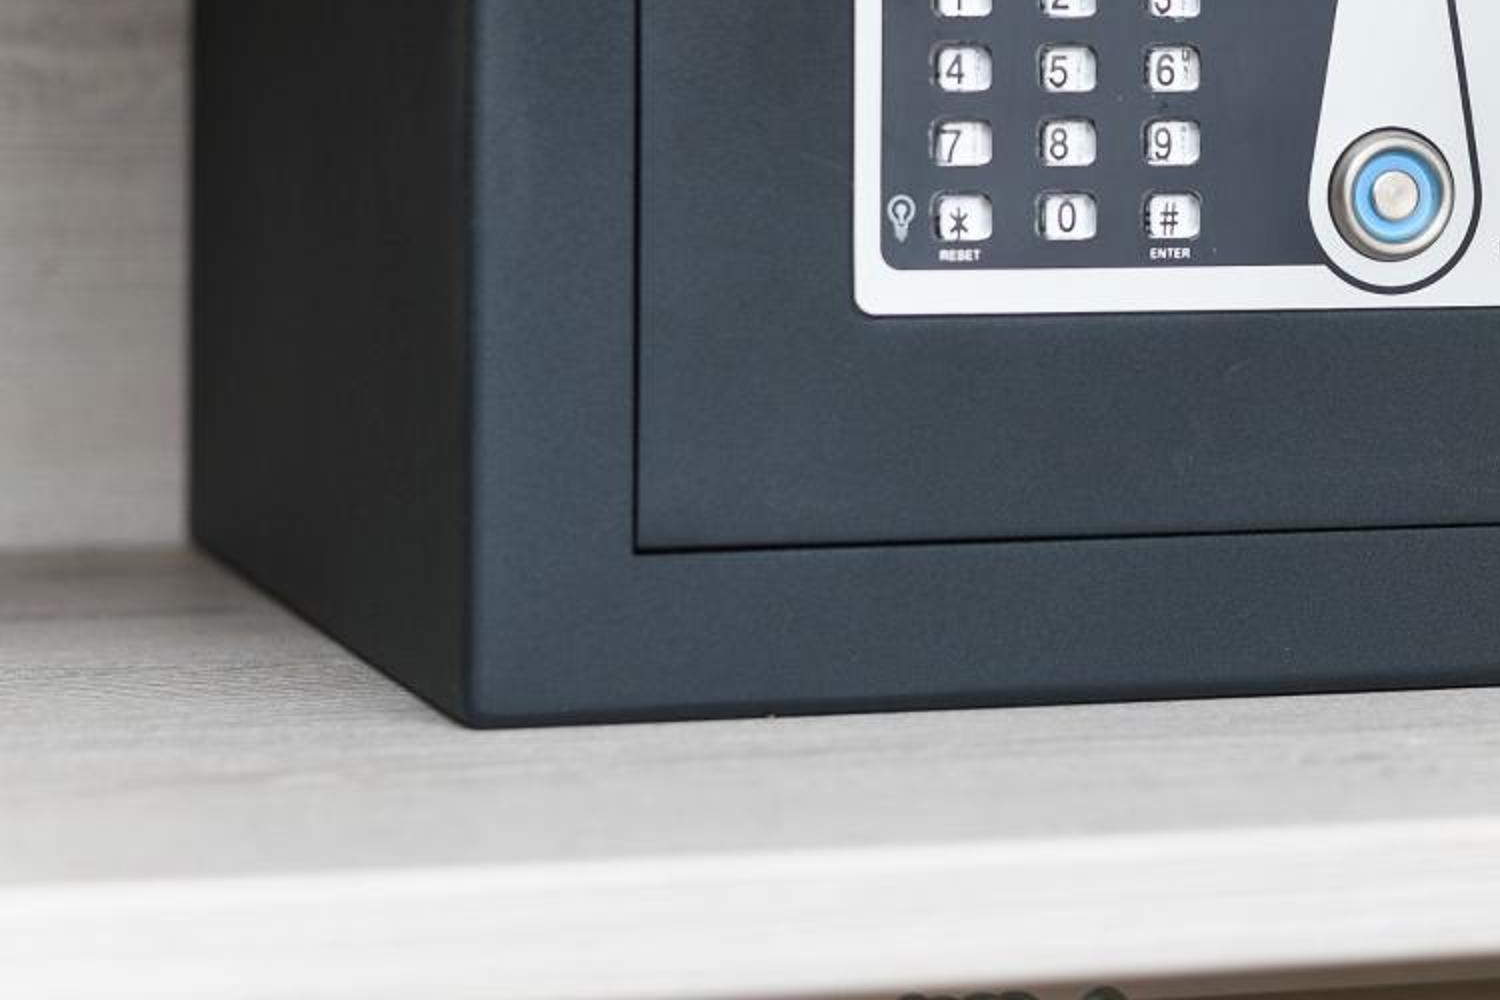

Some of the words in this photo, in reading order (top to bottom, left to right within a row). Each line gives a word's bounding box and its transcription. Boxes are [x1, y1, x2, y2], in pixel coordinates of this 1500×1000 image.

[945, 53, 965, 85] 4
[1049, 55, 1068, 88] 5
[1156, 53, 1176, 86] 6
[940, 128, 962, 163] 7
[1049, 127, 1069, 160] 8
[1154, 127, 1173, 161] 9
[1057, 201, 1077, 233] 0
[1159, 202, 1179, 236] #
[1150, 247, 1191, 259] ENTER
